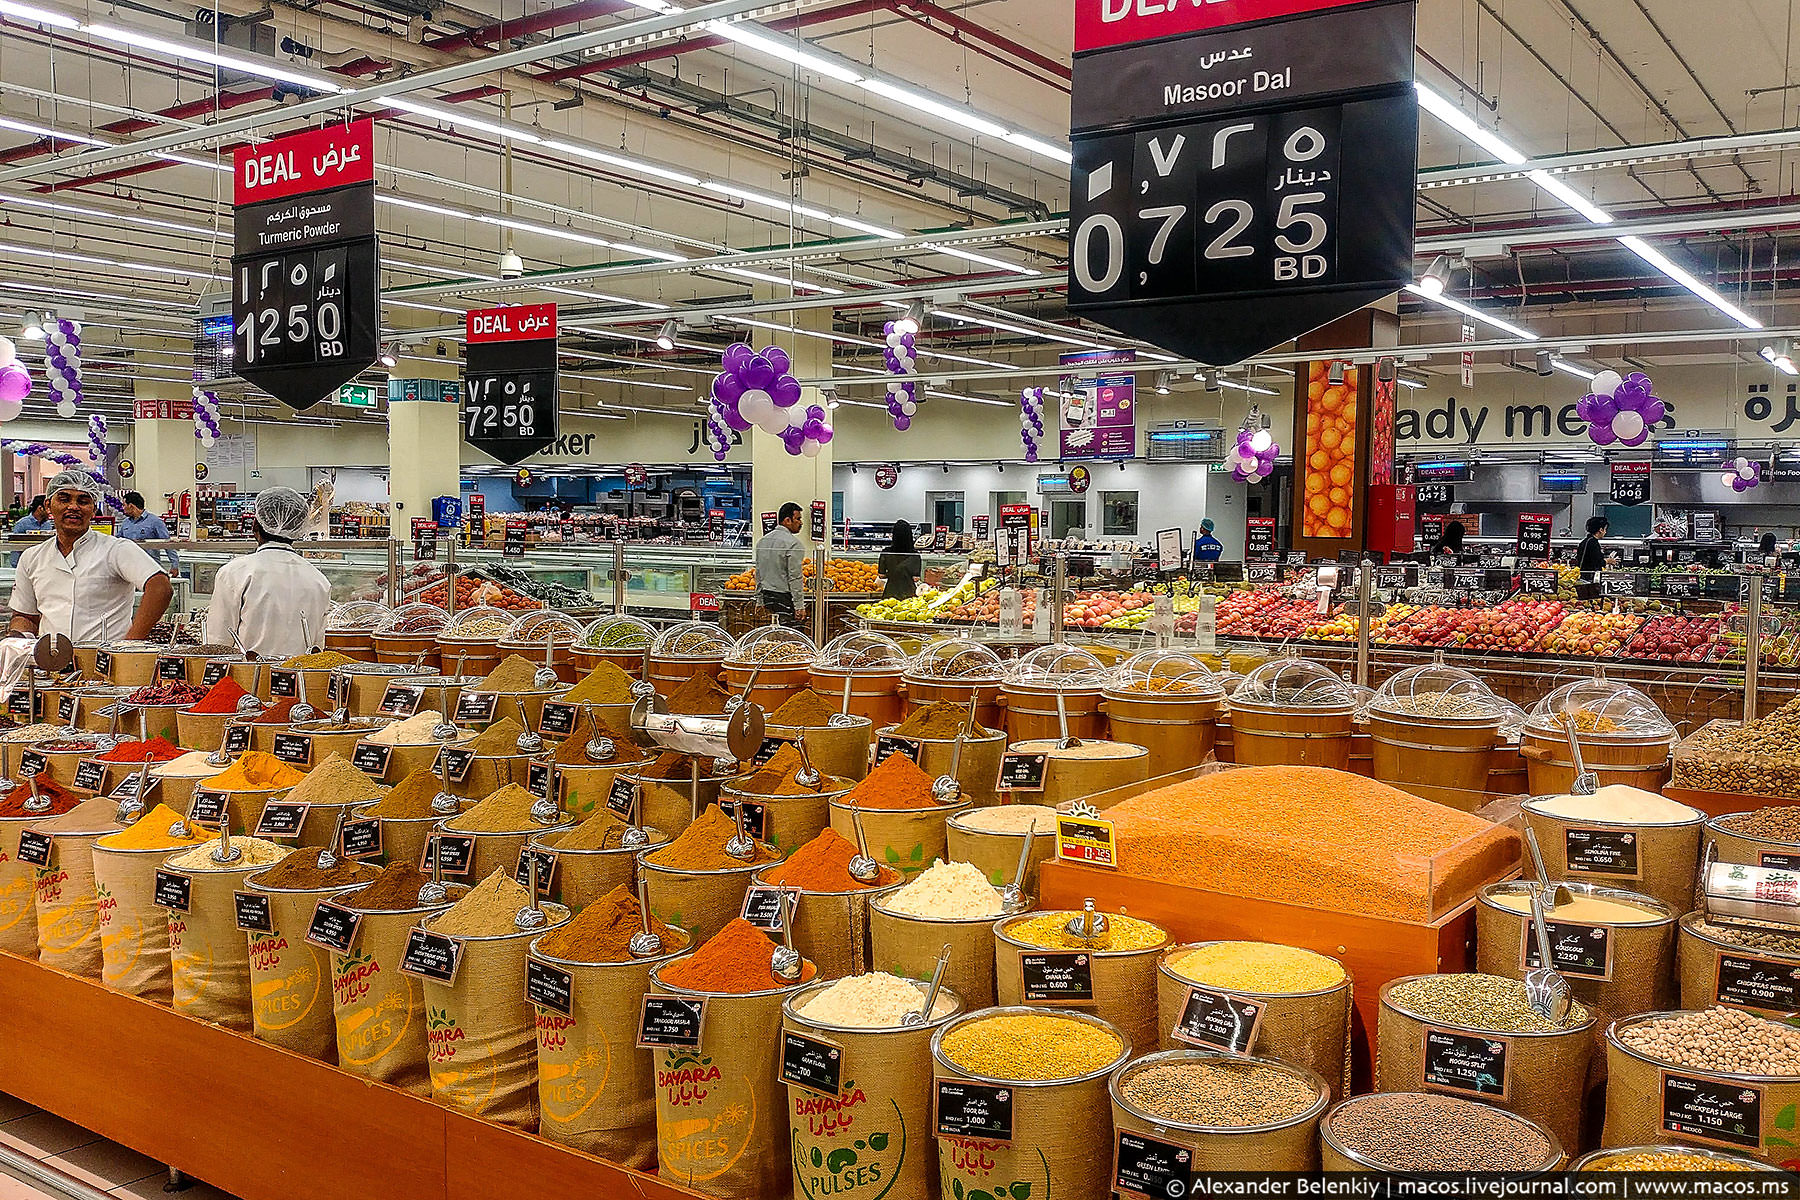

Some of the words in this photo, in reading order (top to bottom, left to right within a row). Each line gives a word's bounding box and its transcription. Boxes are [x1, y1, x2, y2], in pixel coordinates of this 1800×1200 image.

[1200, 45, 1253, 70] عدس
[1164, 76, 1247, 106] Masoor
[1253, 67, 1291, 90] Dal
[244, 150, 301, 188] DEAL
[313, 143, 361, 177] عرض
[1273, 167, 1331, 191] دينار
[266, 206, 298, 226] الكركم
[298, 204, 331, 220] مسحوق
[258, 230, 302, 246] Turmeric
[303, 221, 341, 237] Powder
[1274, 255, 1327, 281] BD
[316, 285, 341, 301] دينار
[473, 315, 511, 335] DEAL
[518, 314, 550, 332] عرض
[319, 341, 344, 357] BD
[519, 426, 535, 436] BD
[699, 597, 718, 607] DEAL
[1736, 979, 1769, 990] CHICKPEAS
[1751, 988, 1775, 998] 0.900
[1208, 1024, 1227, 1034] 1.300
[1449, 1058, 1470, 1067] MOONG
[658, 1066, 722, 1089] BAYARA
[1456, 1068, 1477, 1078] 1.250
[795, 1088, 867, 1117] BAYARA
[963, 1107, 978, 1115] TOOR
[1684, 1103, 1719, 1116] CHICKPEAS
[1719, 1110, 1743, 1120] LARGE
[966, 1116, 986, 1124] 1.000
[1698, 1115, 1723, 1126] 1.150
[1682, 1125, 1703, 1134] MEXICO
[666, 1136, 730, 1162] SPICES
[1136, 1161, 1154, 1171] GREEN
[809, 1162, 883, 1196] PULSES
[1125, 1181, 1143, 1190] CANADA
